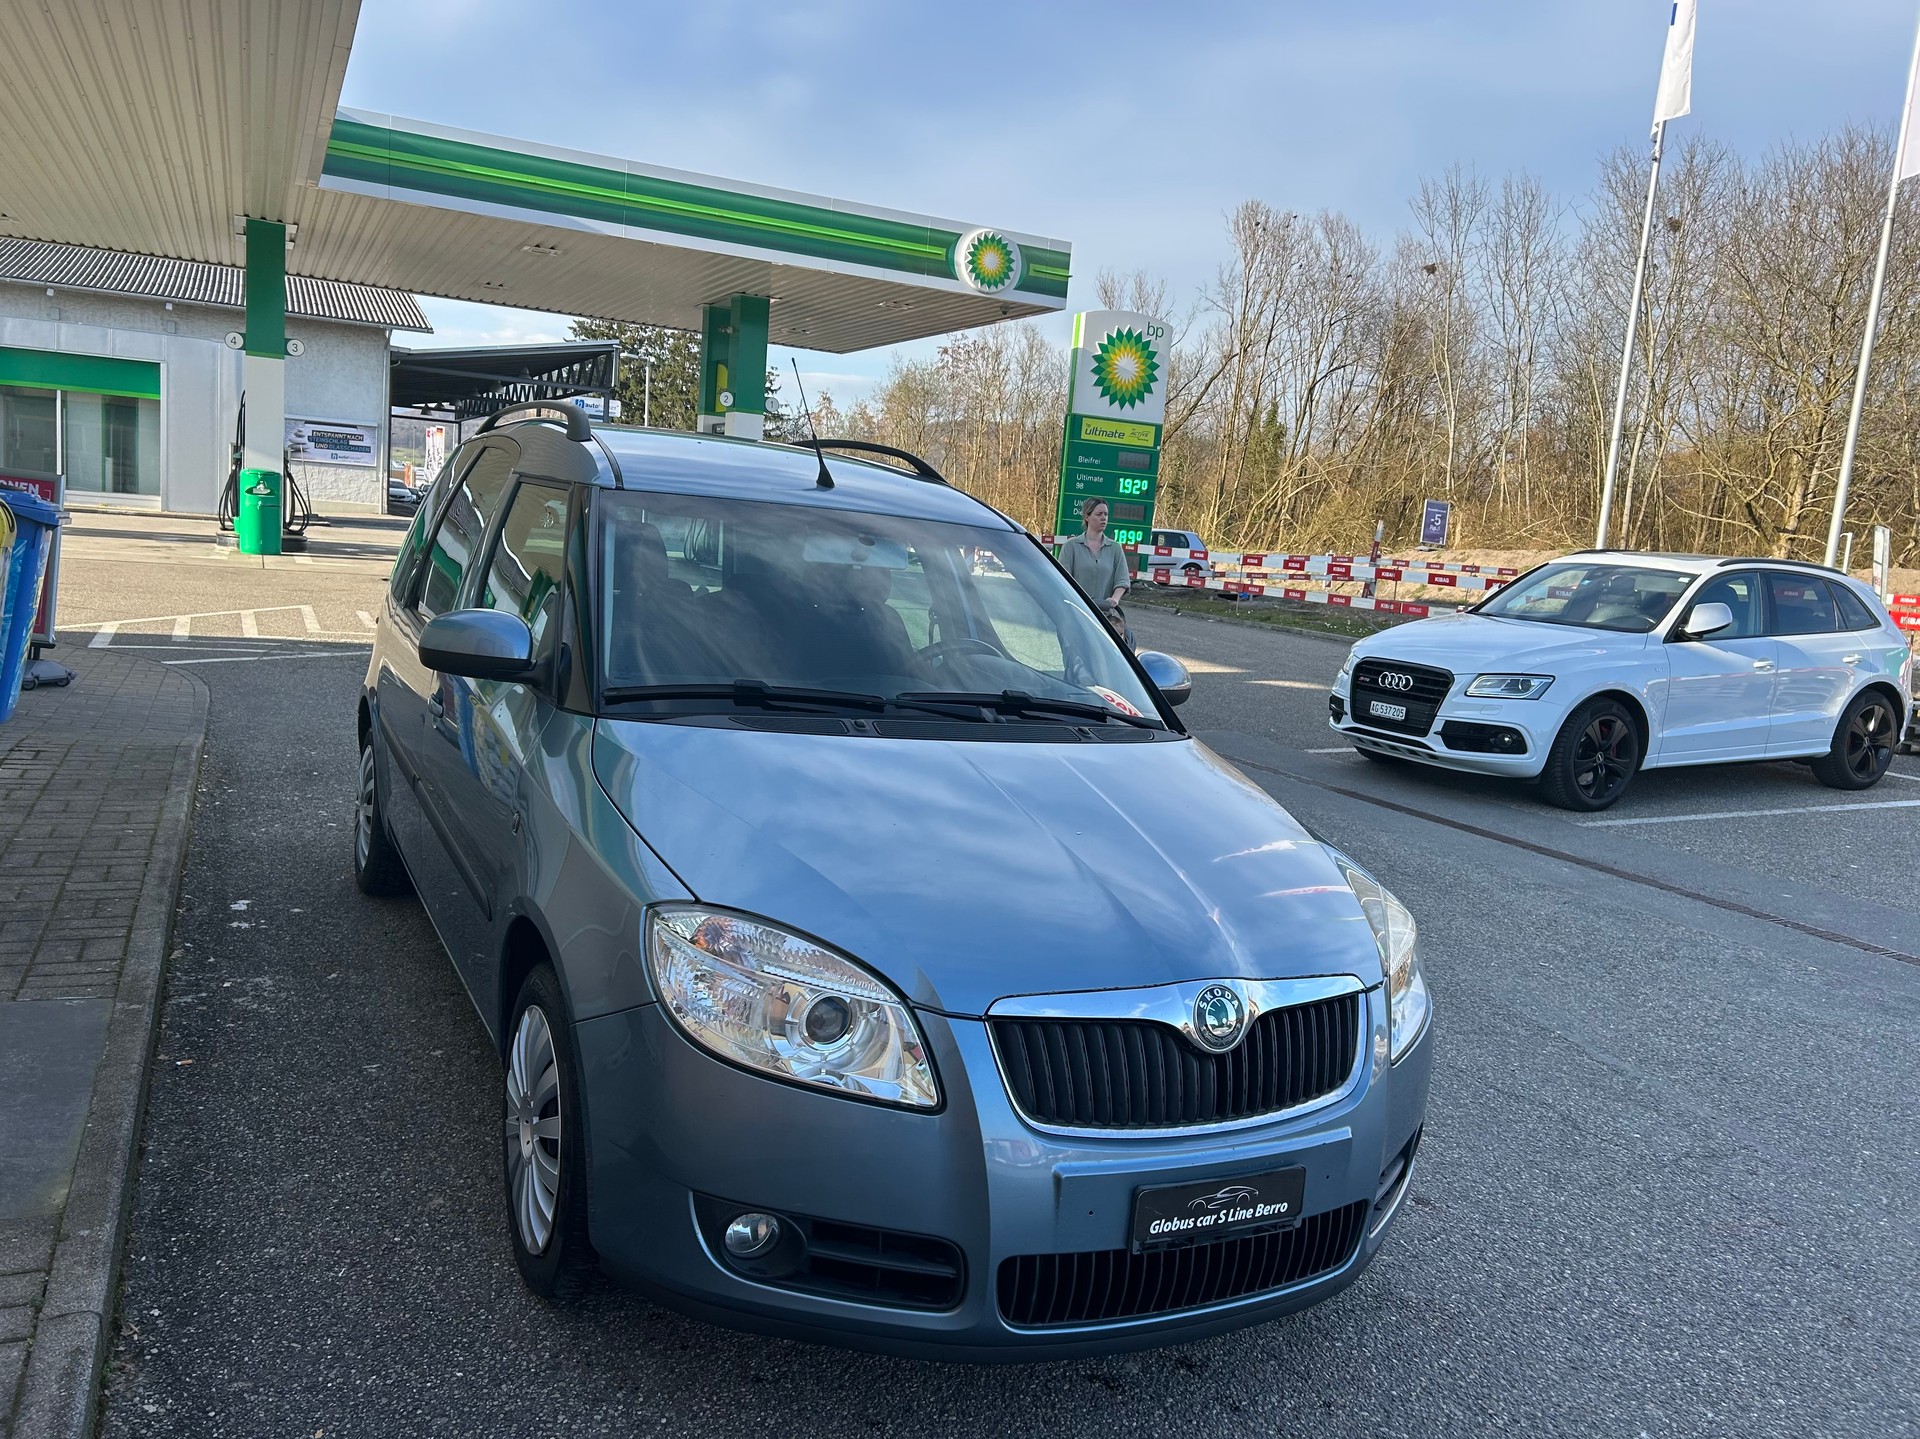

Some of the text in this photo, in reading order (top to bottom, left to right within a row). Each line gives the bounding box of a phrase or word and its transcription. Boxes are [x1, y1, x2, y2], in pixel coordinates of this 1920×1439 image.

[1147, 321, 1164, 341] bp
[230, 336, 237, 345] 4
[292, 343, 298, 353] 3
[723, 395, 729, 404] 2
[770, 401, 774, 409] 1
[313, 431, 348, 440] ENTSPANNT
[1084, 427, 1126, 439] ultimate
[309, 436, 348, 445] STEINSCHLAG
[1078, 455, 1101, 465] Bleifrei
[1076, 474, 1104, 483] Ultimate
[1076, 482, 1084, 490] 98
[1430, 513, 1442, 526] -5
[1434, 576, 1450, 584] KIBAG
[1371, 703, 1404, 718] AG 537 205
[1150, 1202, 1289, 1234] Globus car S Line Berro
